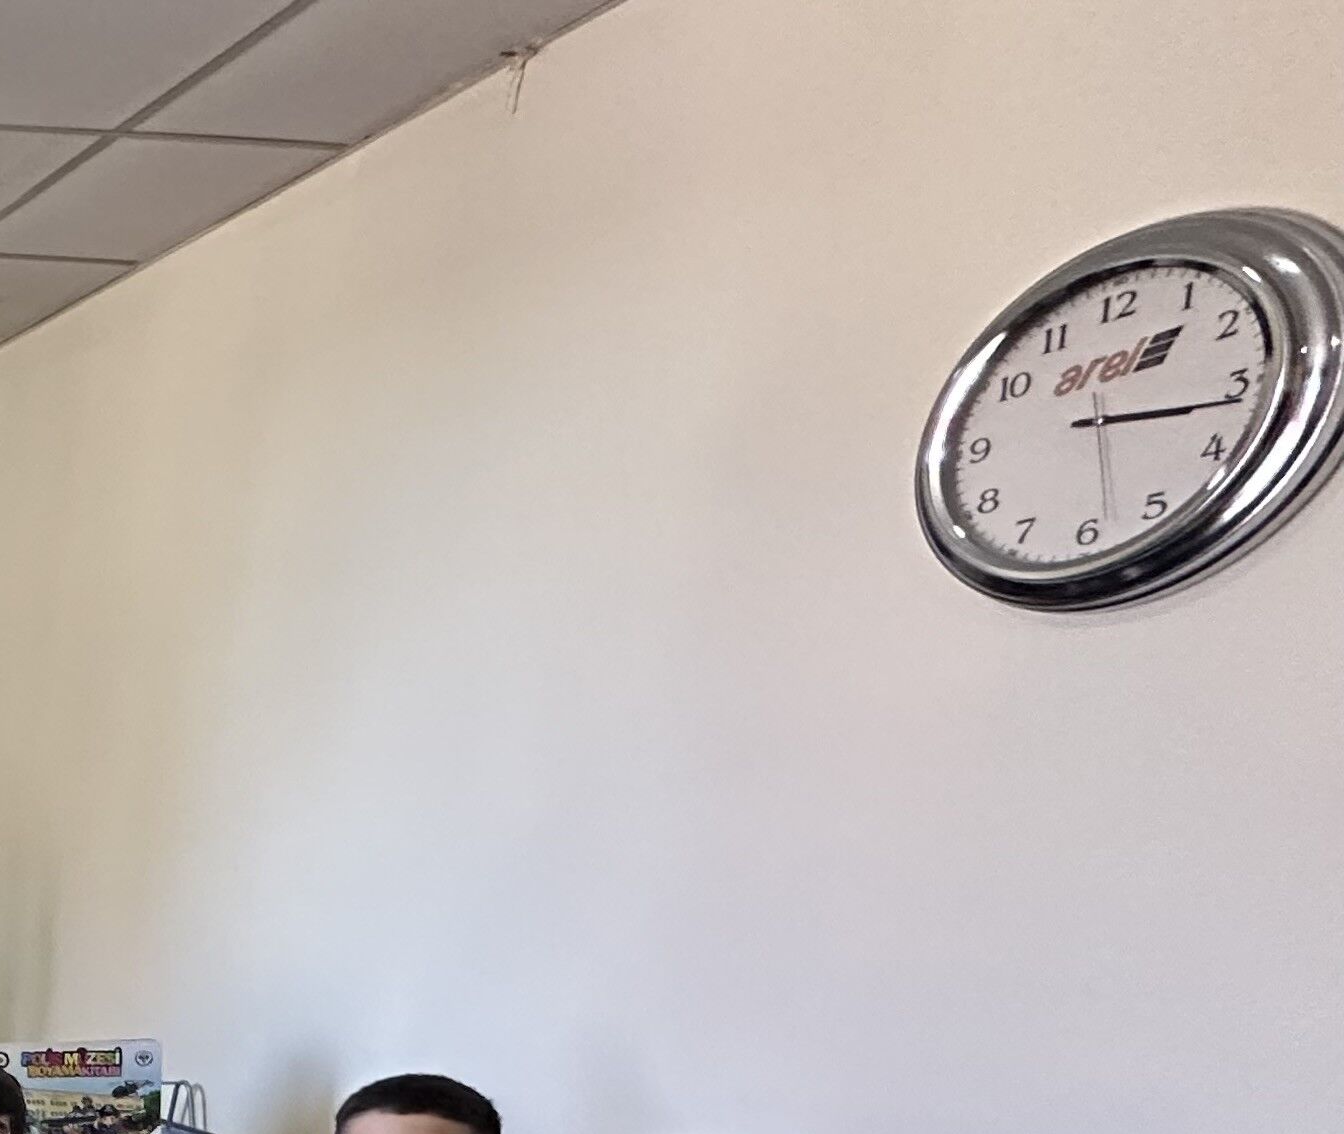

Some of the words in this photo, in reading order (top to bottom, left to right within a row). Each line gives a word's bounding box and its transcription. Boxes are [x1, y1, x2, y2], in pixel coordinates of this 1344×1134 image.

[1098, 290, 1139, 324] 12
[1181, 281, 1195, 312] 1
[1042, 323, 1068, 354] 11
[1214, 309, 1240, 341] 2
[1054, 335, 1150, 397] arel
[999, 372, 1032, 402] 10
[1224, 368, 1249, 399] 3
[968, 437, 992, 464] 9
[1200, 432, 1227, 461] 4
[977, 488, 1000, 514] 8
[1142, 491, 1169, 519] 5
[1015, 517, 1037, 545] 7
[1075, 518, 1100, 546] 6
